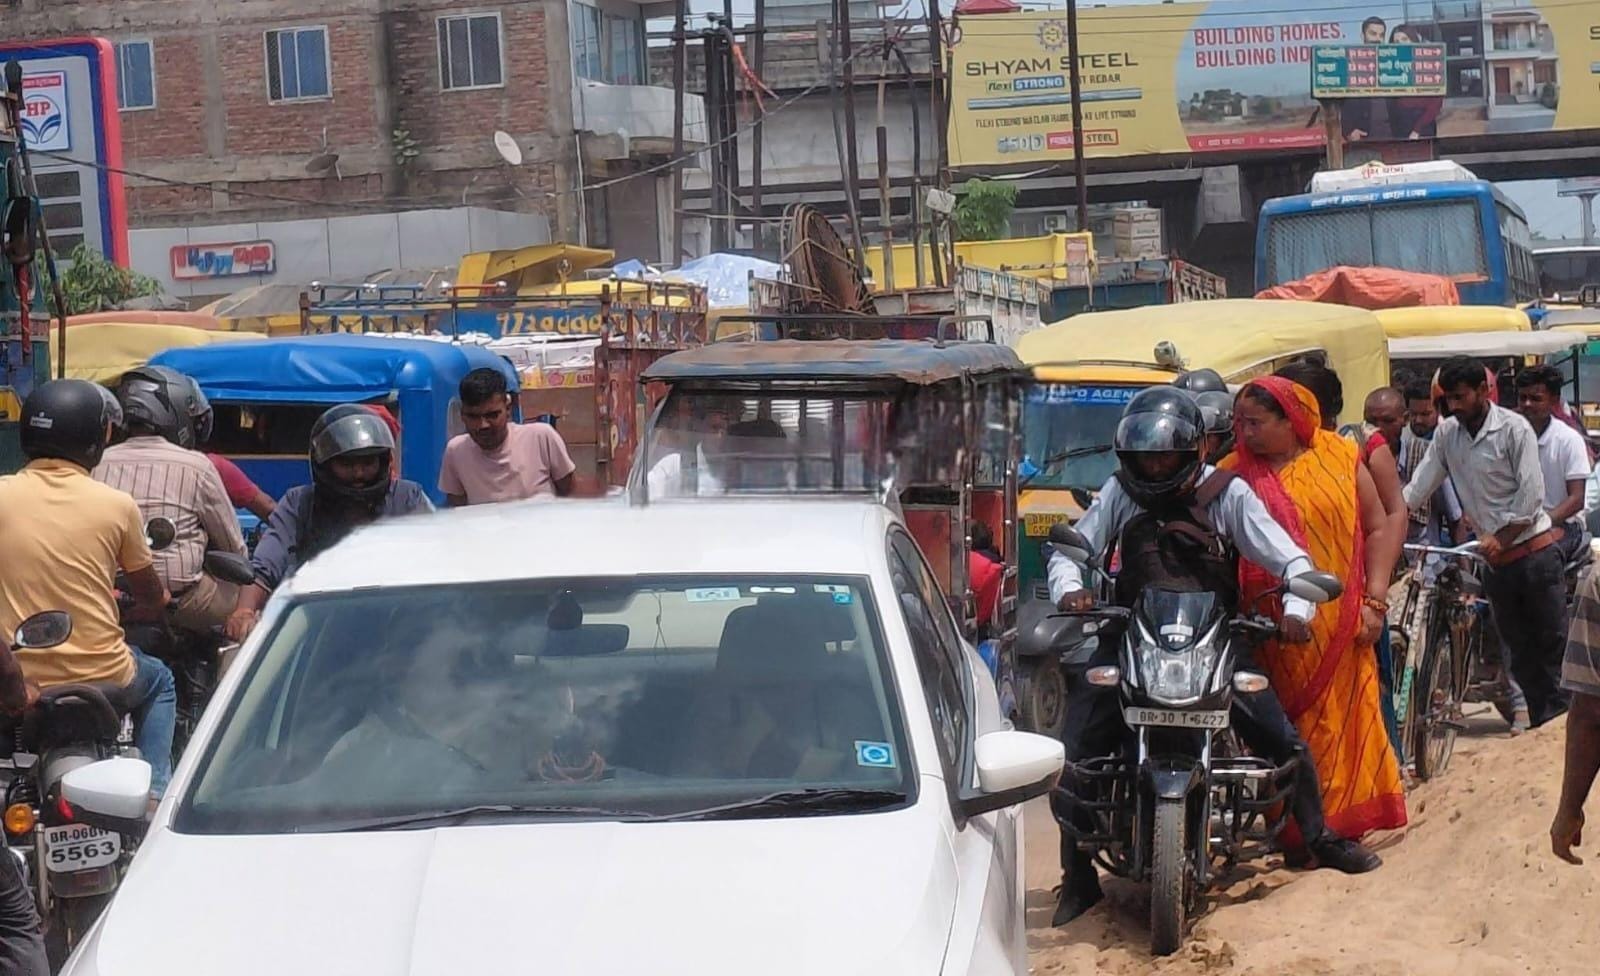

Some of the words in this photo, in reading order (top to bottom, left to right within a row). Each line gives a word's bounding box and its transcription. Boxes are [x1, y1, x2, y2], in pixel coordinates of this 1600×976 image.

[1194, 25, 1275, 46] BUILDING
[1281, 23, 1346, 42] HOMES.
[966, 58, 1050, 76] SHYAM
[1060, 52, 1139, 70] STEEL
[1195, 47, 1277, 68] BUILDING
[1281, 46, 1311, 64] IND
[1015, 77, 1063, 90] STRONG
[26, 101, 50, 116] HP
[1086, 133, 1114, 143] STEEL
[1091, 389, 1133, 399] AGEN
[51, 841, 115, 863] 5563
